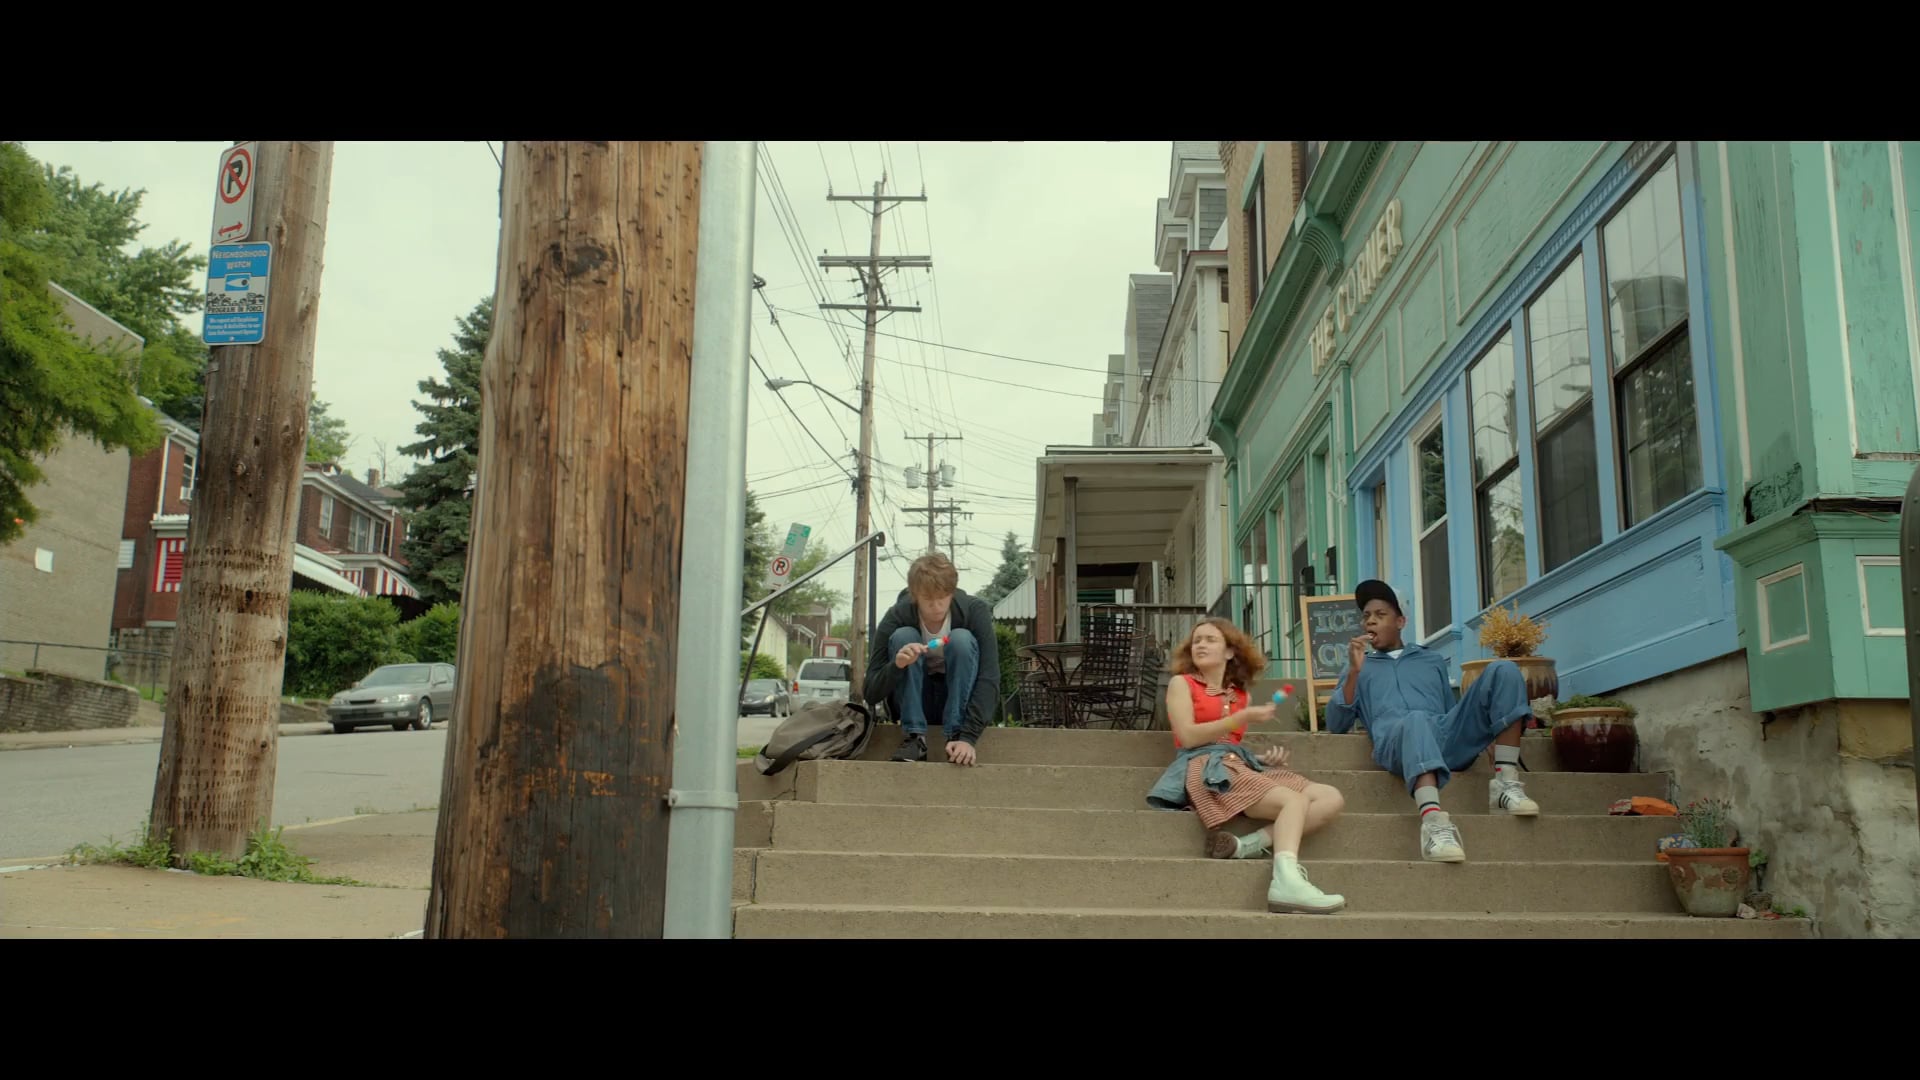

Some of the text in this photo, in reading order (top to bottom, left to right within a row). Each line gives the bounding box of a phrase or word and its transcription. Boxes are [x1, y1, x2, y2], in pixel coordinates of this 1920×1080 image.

[1308, 198, 1403, 377] THE CORNER
[1313, 609, 1361, 633] ICE
[1318, 643, 1350, 667] CR
